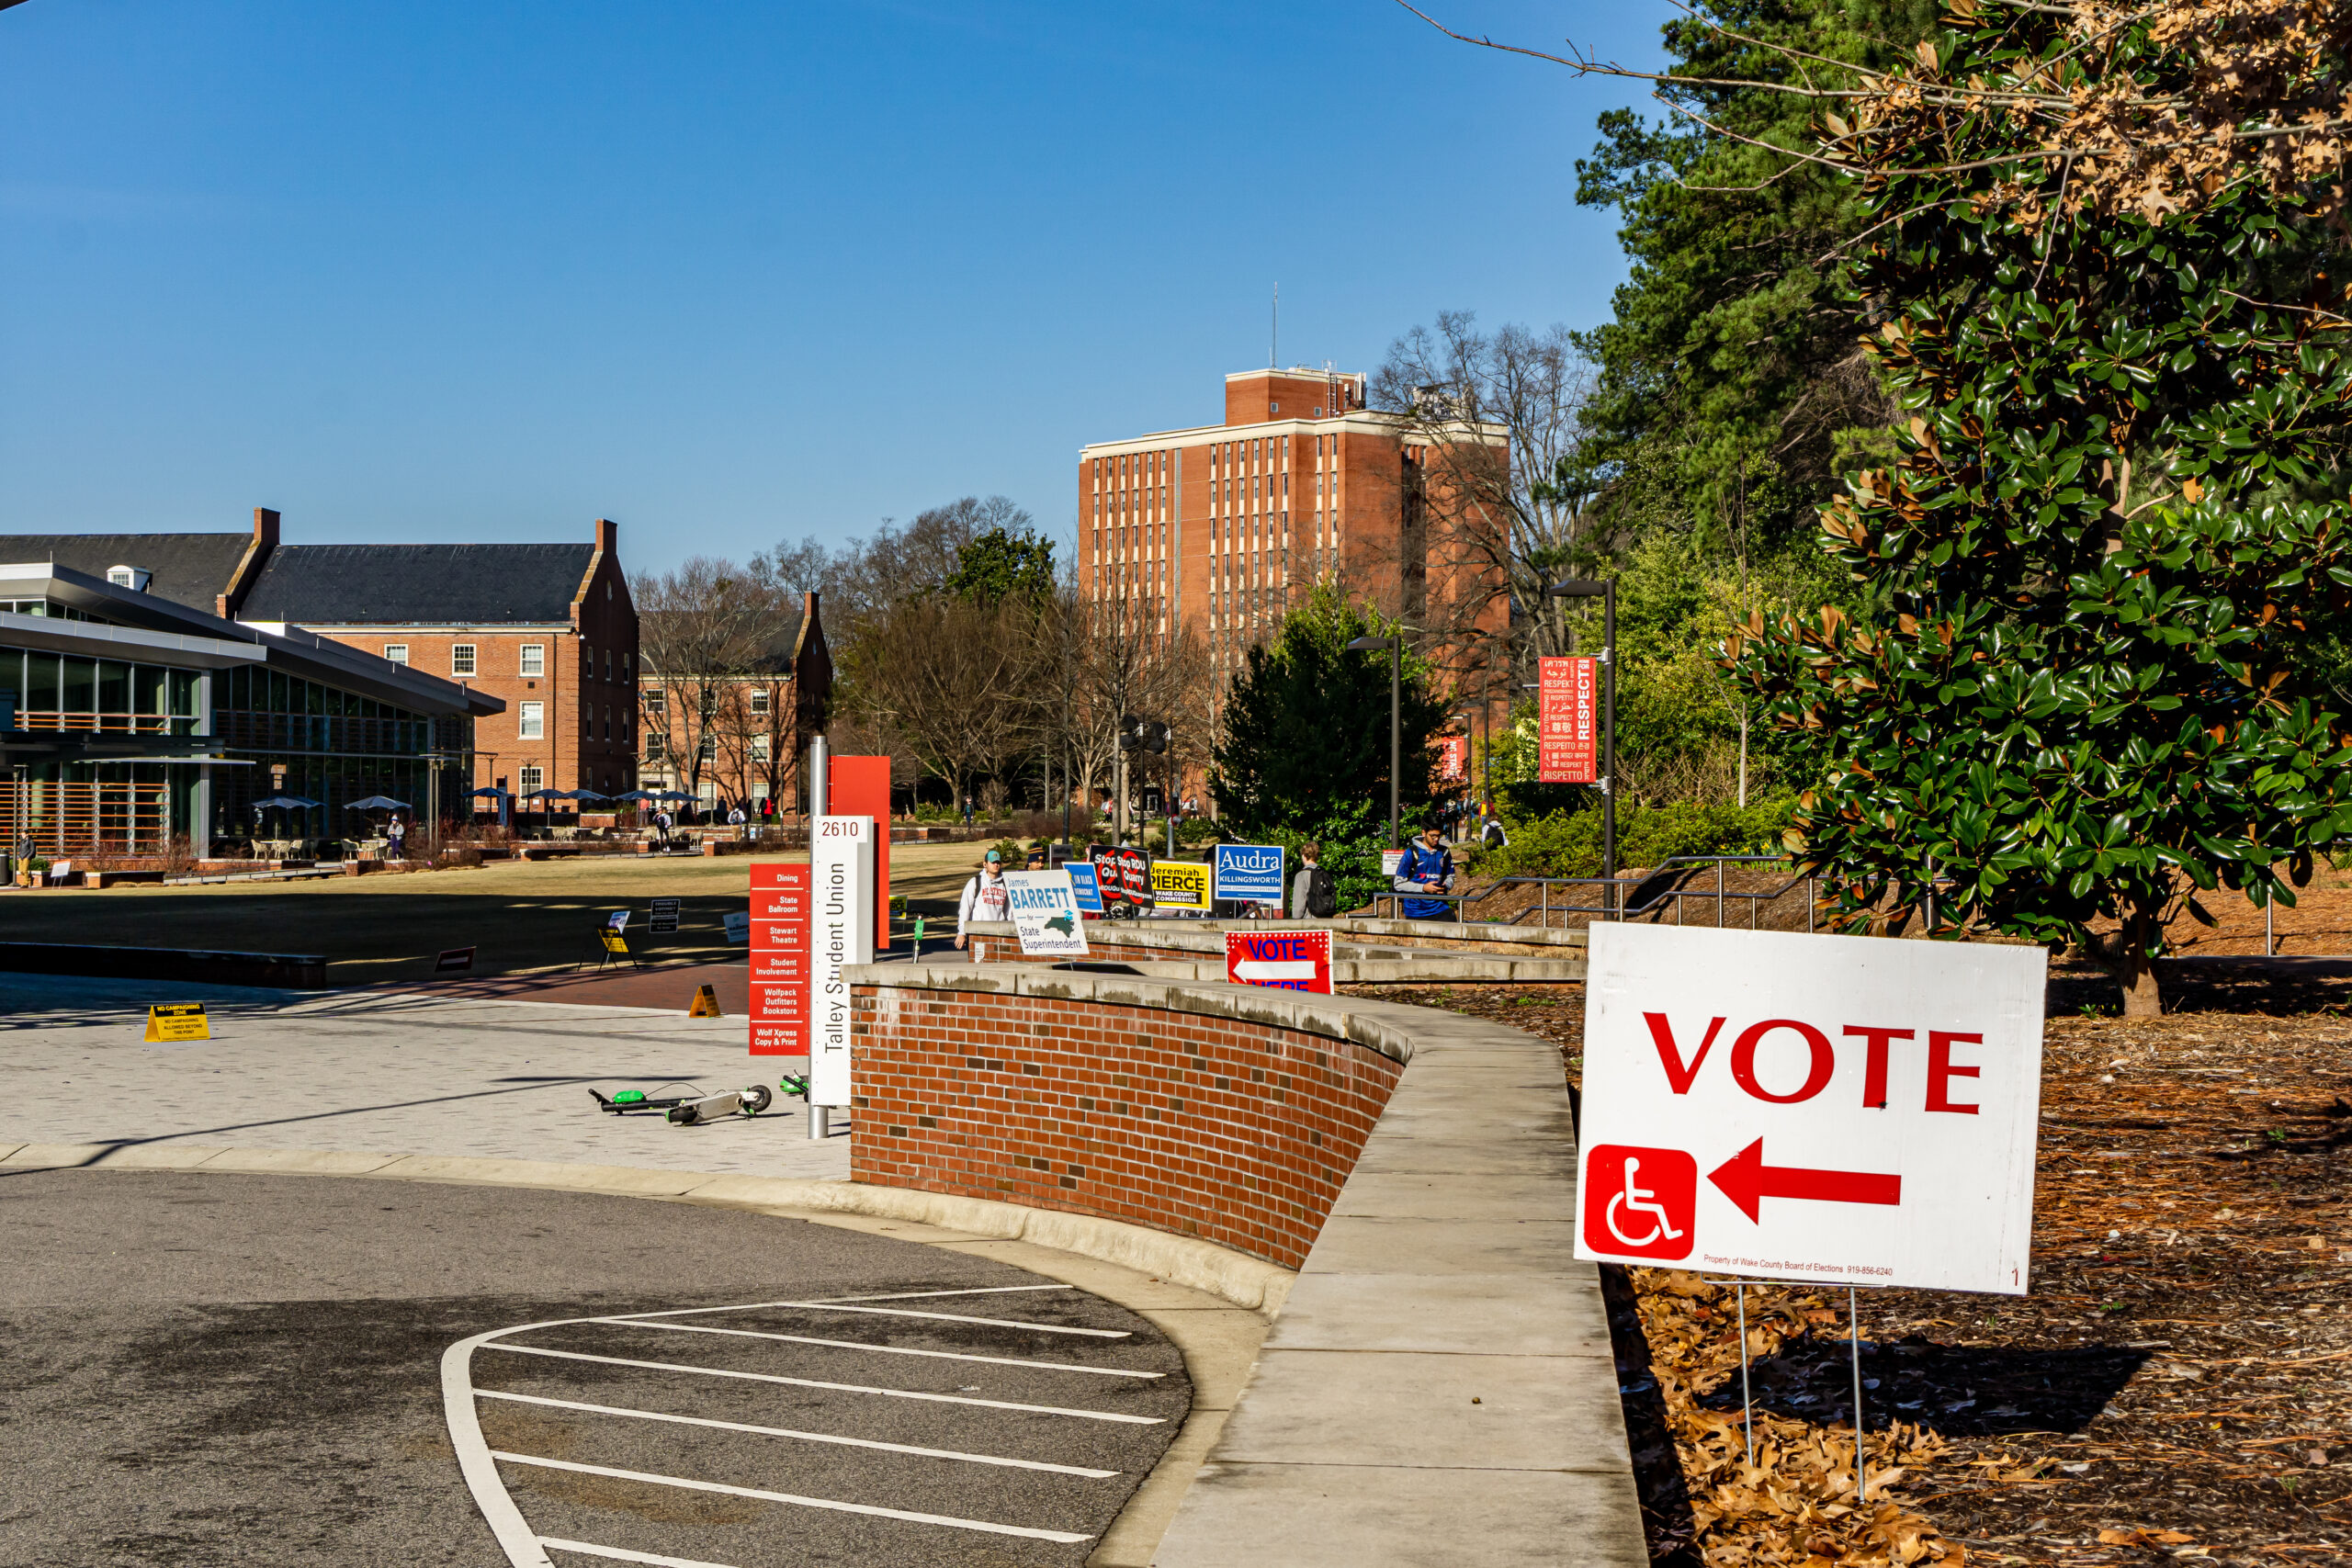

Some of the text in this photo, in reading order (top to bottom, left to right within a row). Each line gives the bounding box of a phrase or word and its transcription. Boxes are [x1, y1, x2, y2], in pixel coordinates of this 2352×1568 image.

[1578, 669, 1589, 740] RESPECT
[1544, 771, 1582, 780] RISPETTO
[822, 822, 858, 836] 2610
[1131, 858, 1146, 871] RDU
[1219, 851, 1280, 868] Audra
[1151, 867, 1200, 876] Jeremiah
[777, 874, 797, 883] Dining
[1008, 878, 1029, 887] James
[1124, 870, 1144, 886] Quarry
[1219, 875, 1280, 884] KILLINGSWORTH
[1011, 887, 1070, 909] BARRETT
[768, 905, 797, 913] Ballroom
[1020, 927, 1040, 937] State
[1023, 939, 1082, 951] Superintendent
[1249, 939, 1307, 960] VOTE
[825, 863, 847, 1054] Talley Student Union
[764, 988, 797, 997] Wolfpack
[775, 1029, 797, 1037] Xpress
[755, 1038, 772, 1046] Copy
[1643, 1011, 1984, 1115] VOTE
[1703, 1254, 1731, 1266] Property
[1740, 1258, 1758, 1267] Wake
[1759, 1259, 1782, 1269] County
[1784, 1260, 1804, 1270] Board
[1814, 1263, 1843, 1273] Elections
[1847, 1266, 1893, 1276] 919-856-6240
